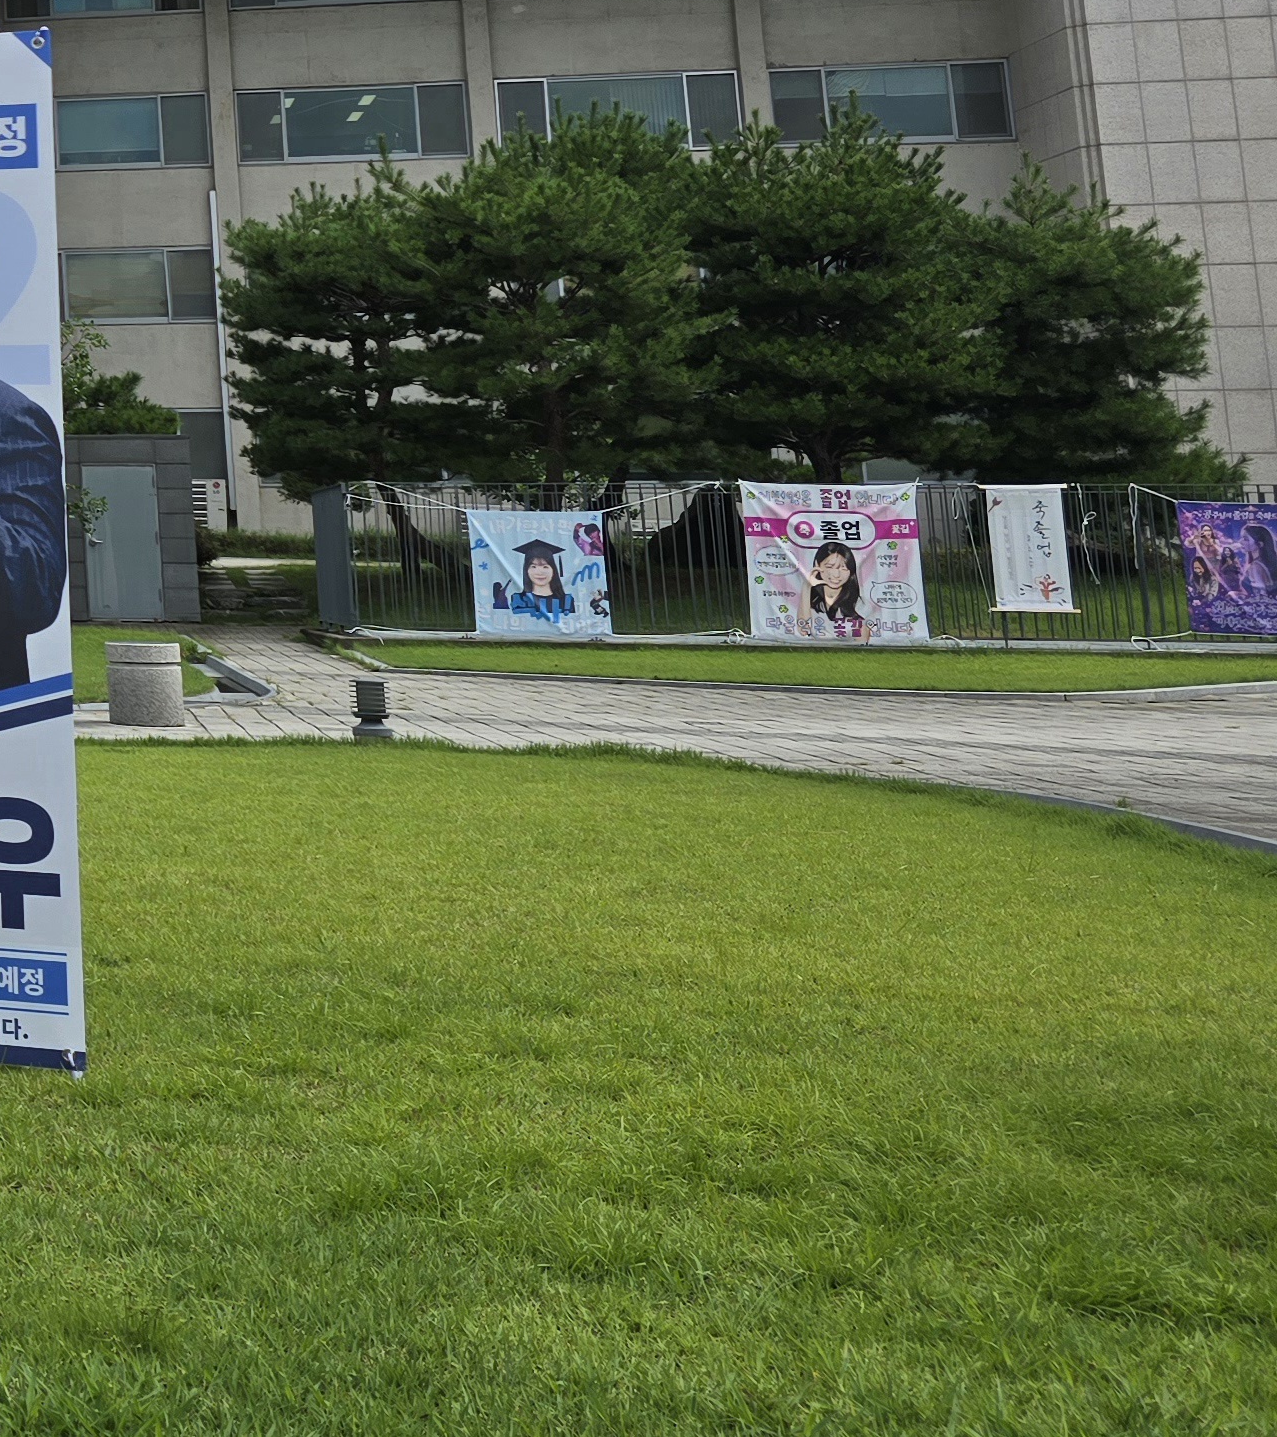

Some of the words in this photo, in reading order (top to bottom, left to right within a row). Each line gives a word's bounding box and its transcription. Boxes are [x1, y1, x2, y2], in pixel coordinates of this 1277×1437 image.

[819, 488, 851, 510] 졸업
[819, 520, 862, 541] 졸업
[834, 617, 863, 638] 꽃길
